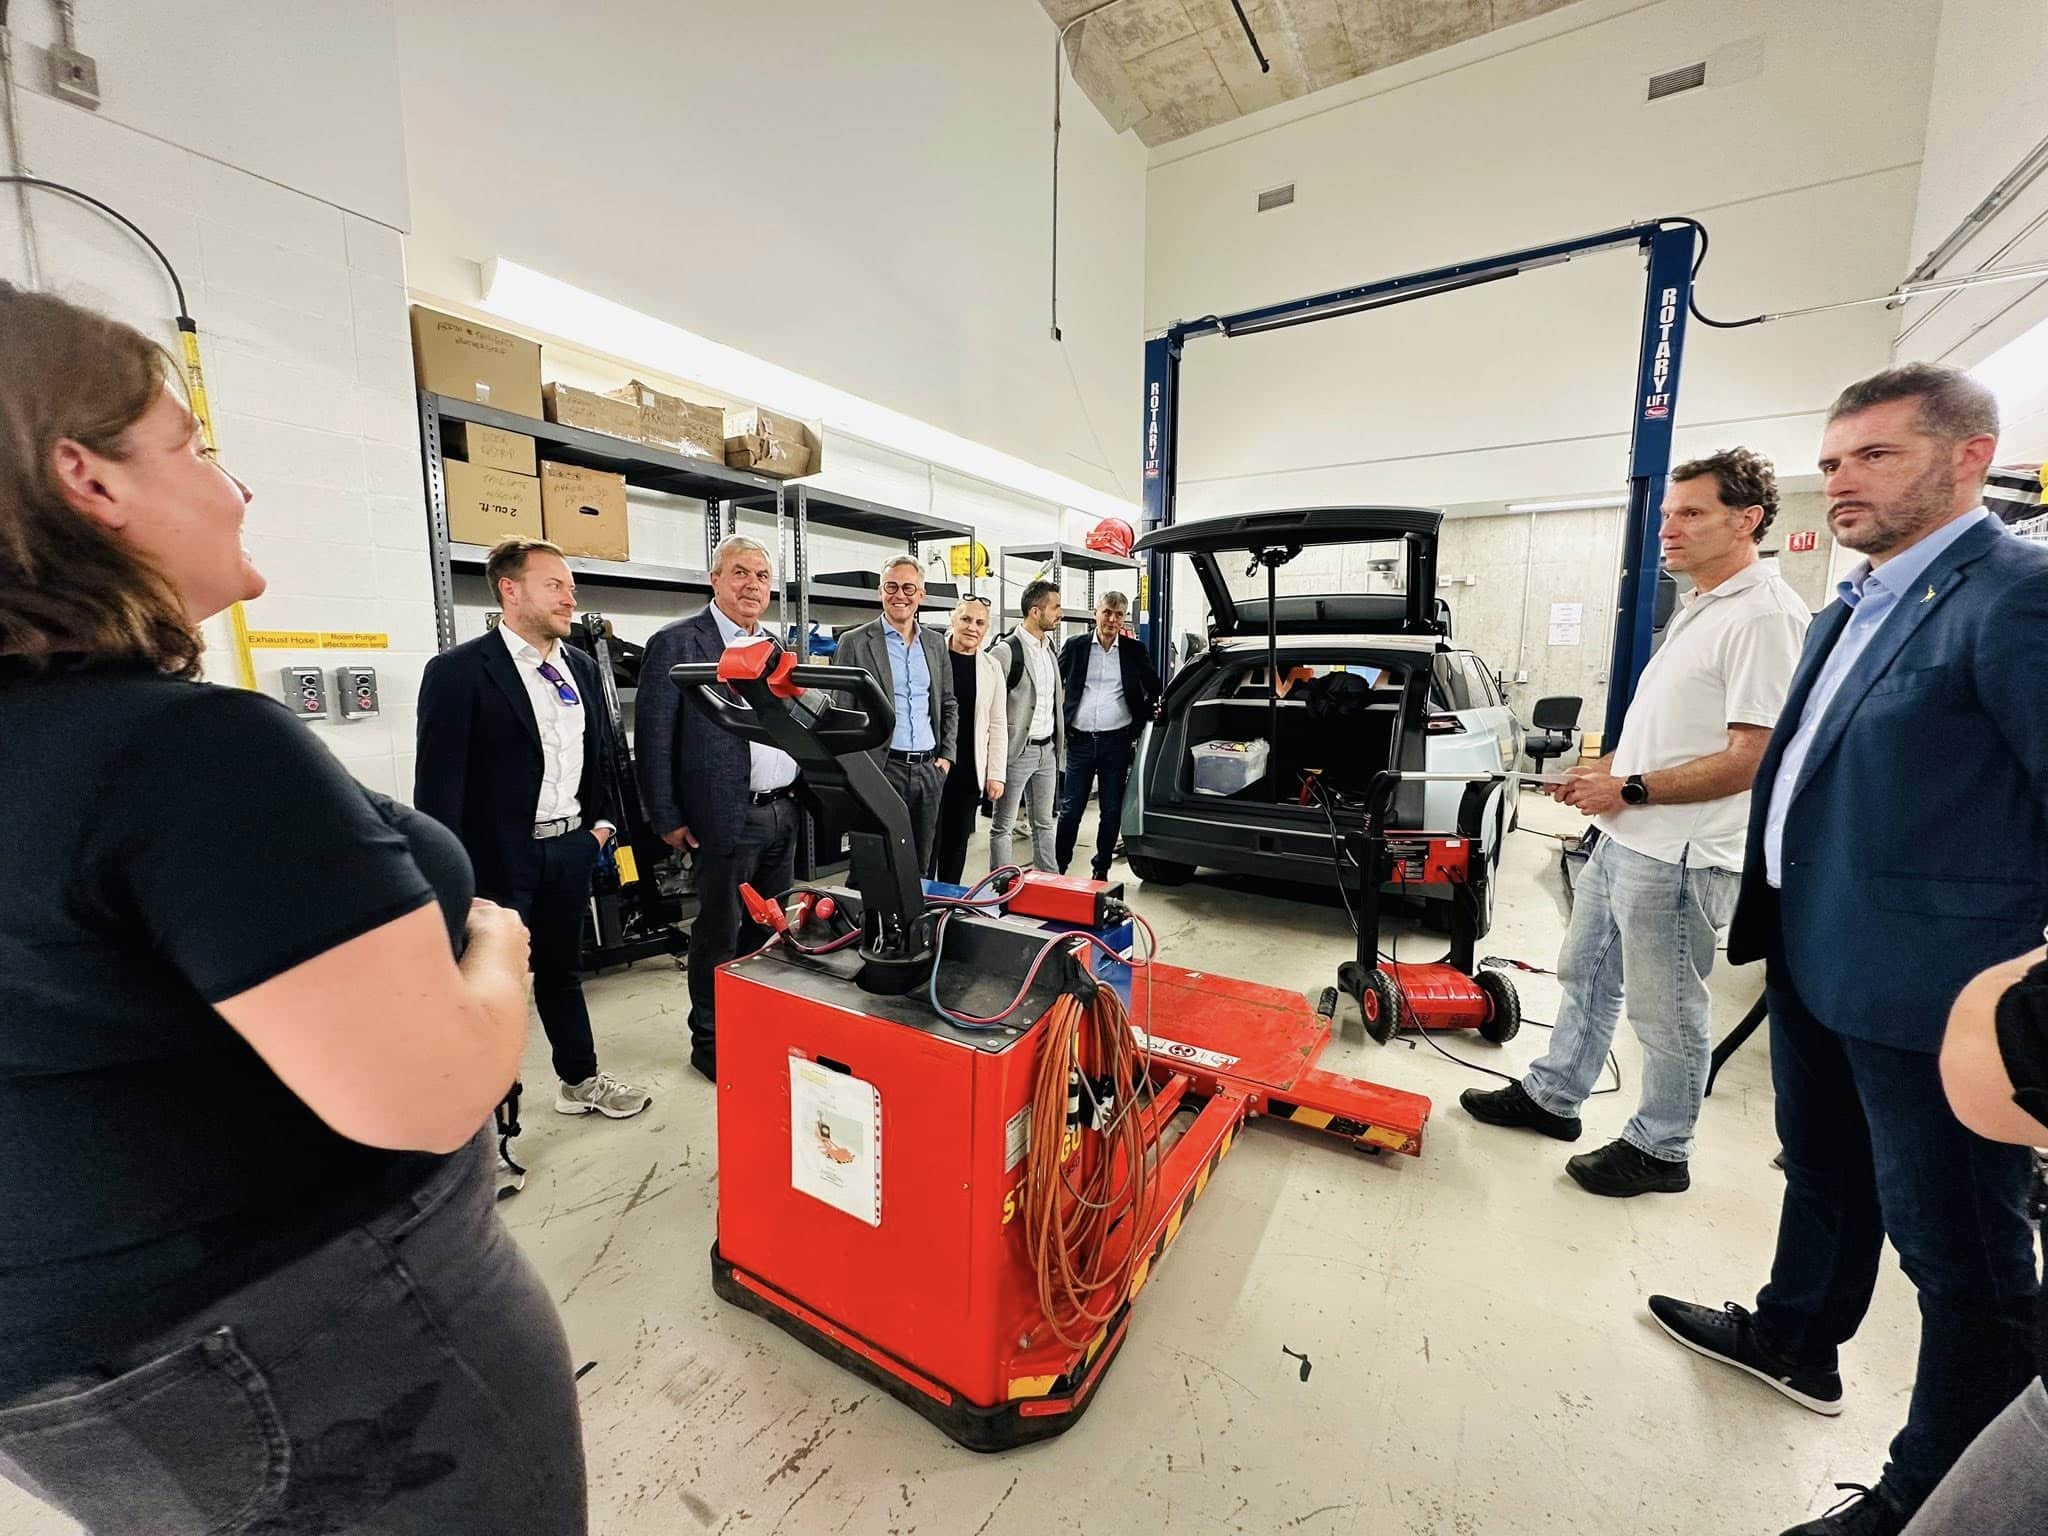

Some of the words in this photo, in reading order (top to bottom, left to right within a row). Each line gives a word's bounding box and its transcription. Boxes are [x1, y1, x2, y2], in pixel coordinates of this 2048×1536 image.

[1653, 287, 1678, 393] ROTARY
[1645, 393, 1671, 407] LIFT
[1148, 382, 1160, 460] ROTARY
[1145, 459, 1160, 470] LIFT
[478, 502, 490, 513] ft.
[492, 504, 508, 514] cu.
[510, 507, 518, 517] 2
[248, 635, 288, 644] Exhaust
[290, 636, 315, 645] Hose
[330, 633, 353, 641] Room
